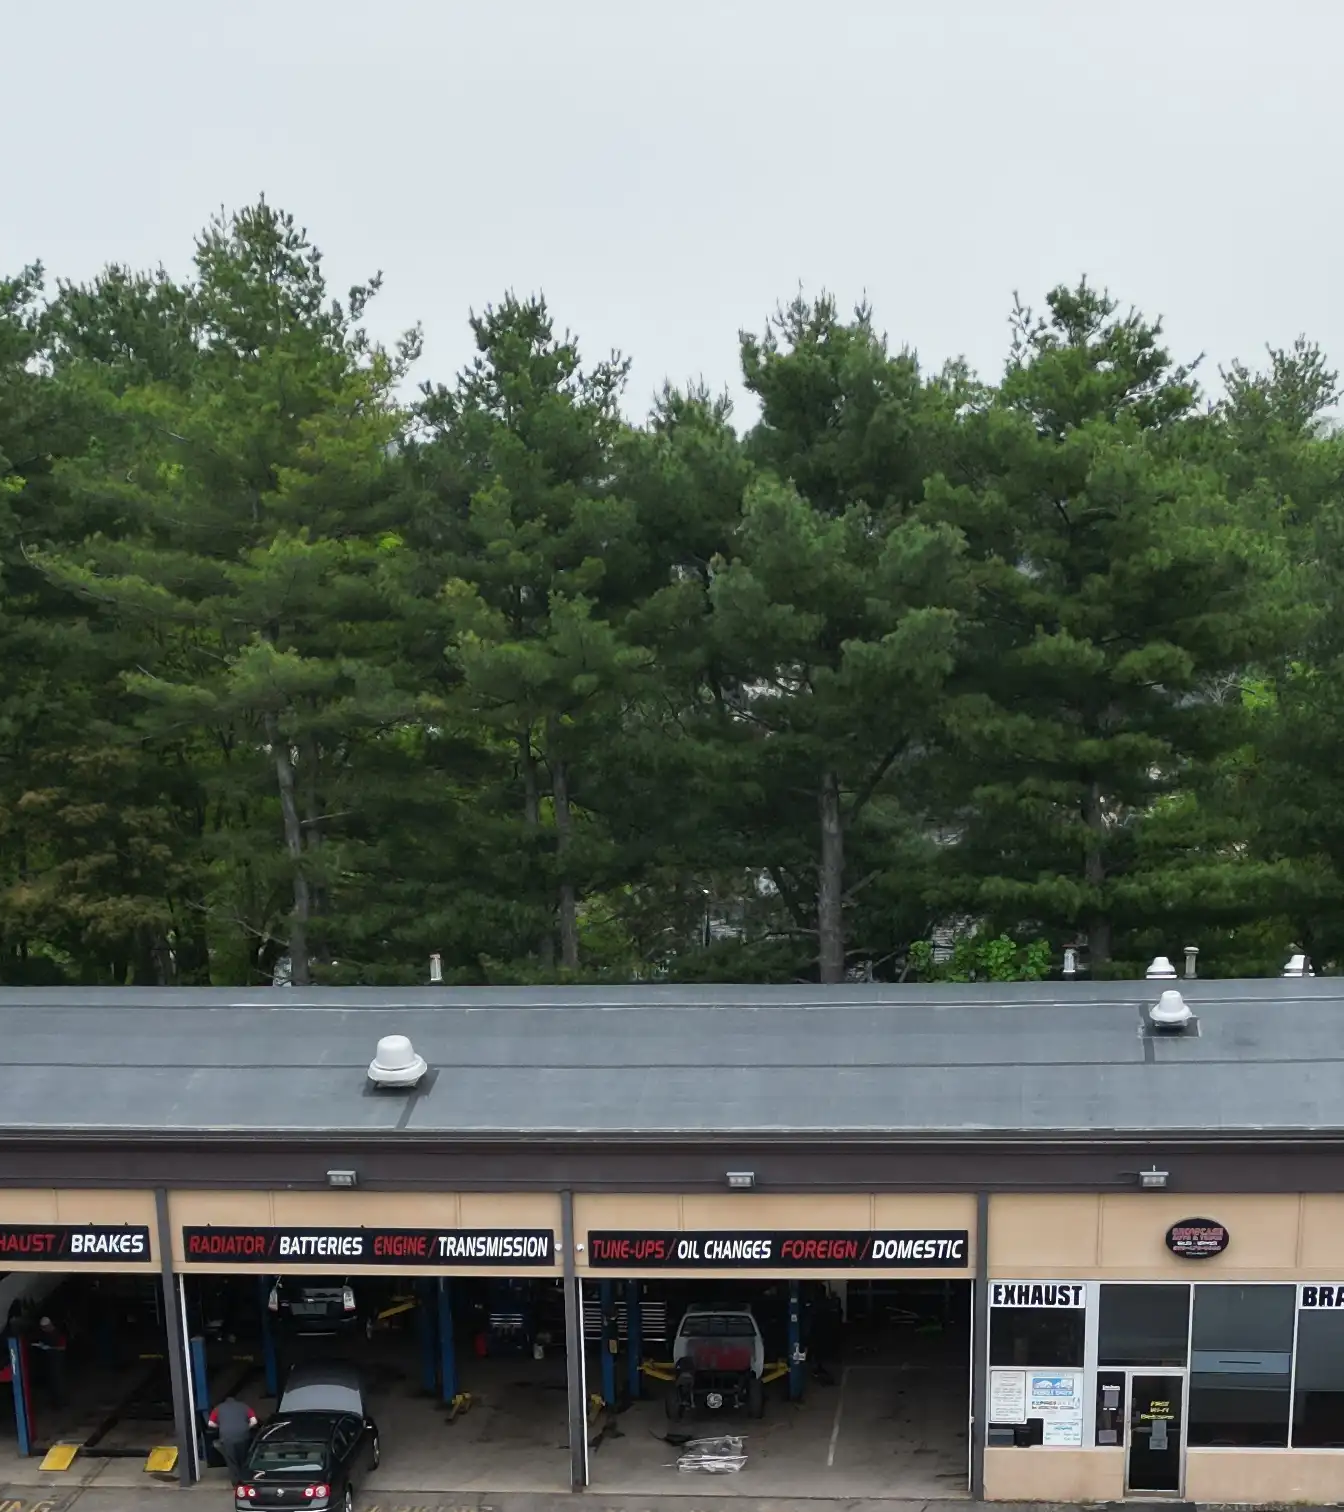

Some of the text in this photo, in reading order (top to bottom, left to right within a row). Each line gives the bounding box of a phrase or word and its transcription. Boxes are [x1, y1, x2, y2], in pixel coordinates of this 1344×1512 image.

[71, 1234, 144, 1253] BRAKES
[189, 1235, 264, 1253] RADIATOR
[279, 1236, 363, 1255] BATTERIES
[374, 1236, 426, 1255] ENGINE
[439, 1236, 548, 1257] TRANSMISSION
[592, 1240, 665, 1259] TUNE-UPS
[677, 1241, 700, 1259] OIL
[704, 1240, 772, 1259] CHANGES
[781, 1240, 858, 1258] FOREIGN
[872, 1240, 964, 1259] DOMESTIC
[993, 1285, 1083, 1306] EXHAUST
